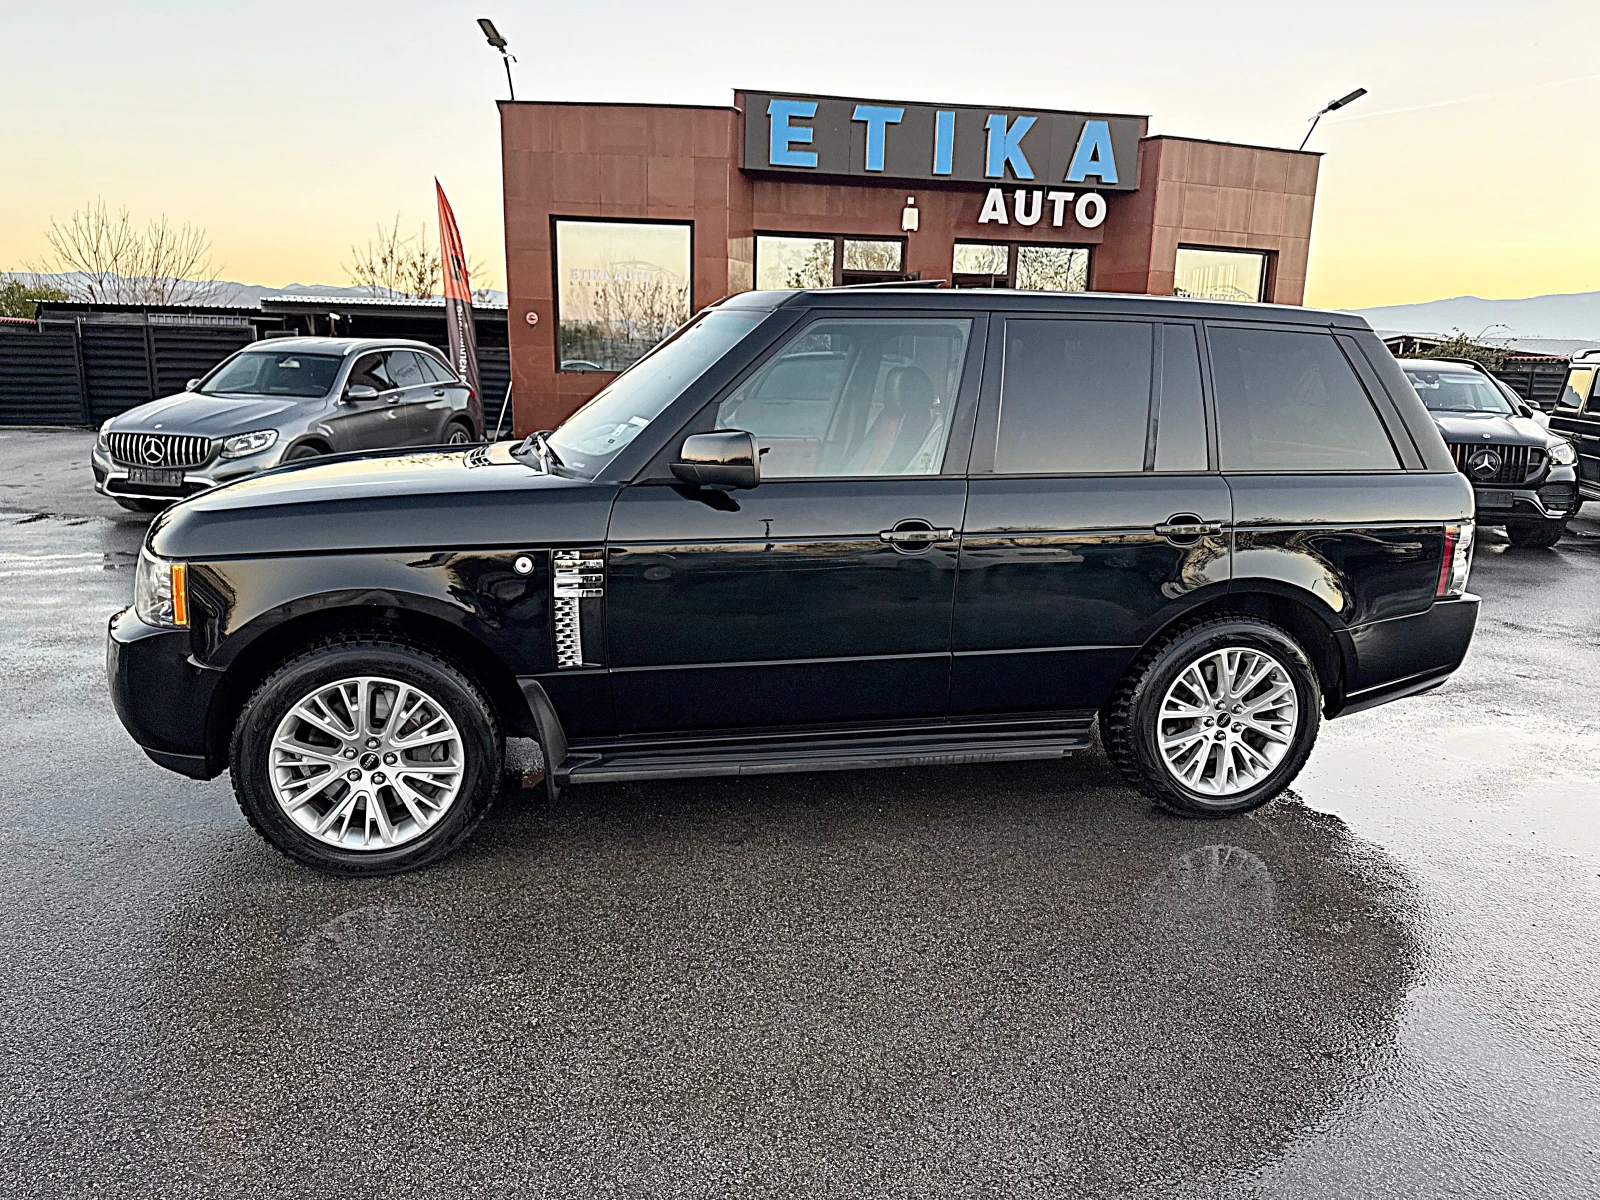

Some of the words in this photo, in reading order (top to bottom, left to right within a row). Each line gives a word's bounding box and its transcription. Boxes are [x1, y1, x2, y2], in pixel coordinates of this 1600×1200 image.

[766, 98, 1119, 184] ETIKA
[977, 187, 1107, 229] AUTO
[569, 268, 611, 280] ETIKA
[613, 270, 653, 282] AUTO
